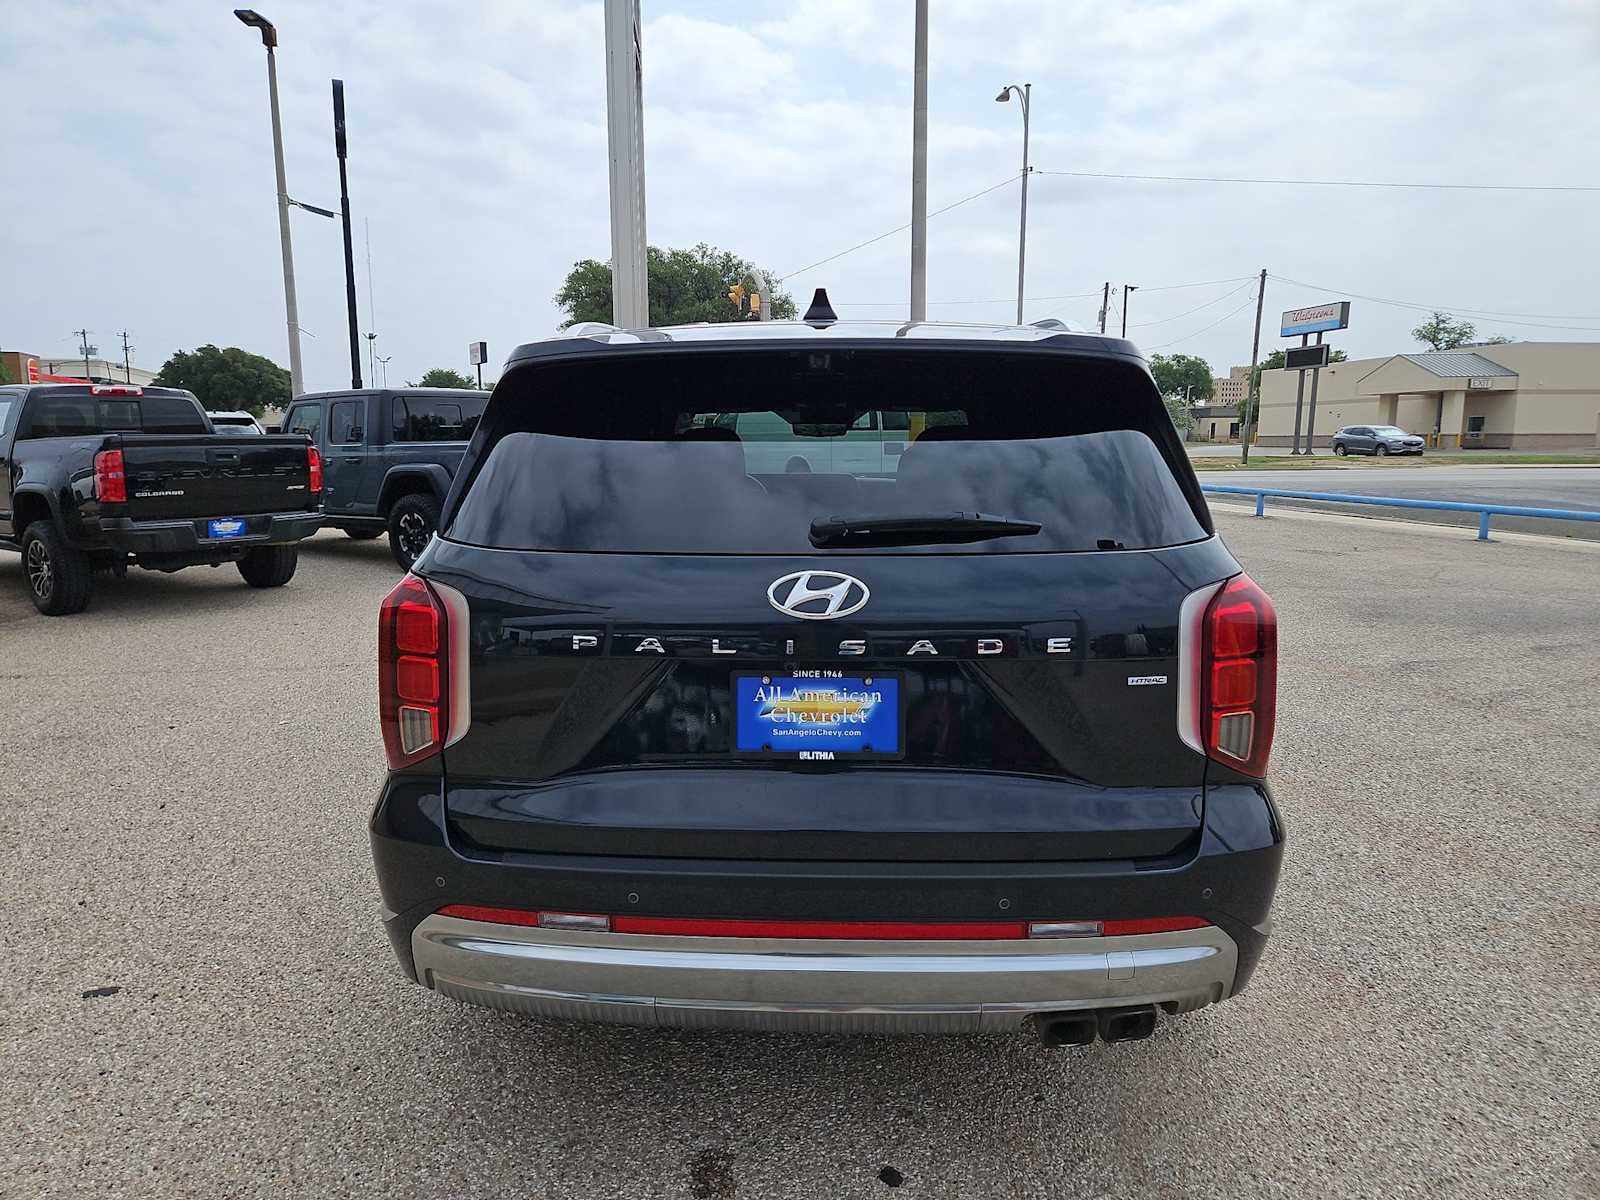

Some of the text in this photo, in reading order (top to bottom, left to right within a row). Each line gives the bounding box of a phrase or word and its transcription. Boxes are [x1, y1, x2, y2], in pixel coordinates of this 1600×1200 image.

[1472, 379, 1490, 388] EXIT
[572, 635, 1074, 655] PALISADE
[792, 670, 820, 678] SINCE
[1127, 676, 1168, 686] HTRAC
[753, 686, 882, 703] All American
[771, 707, 867, 724] Chevrolet
[772, 728, 862, 738] SanAngeloChevy.com
